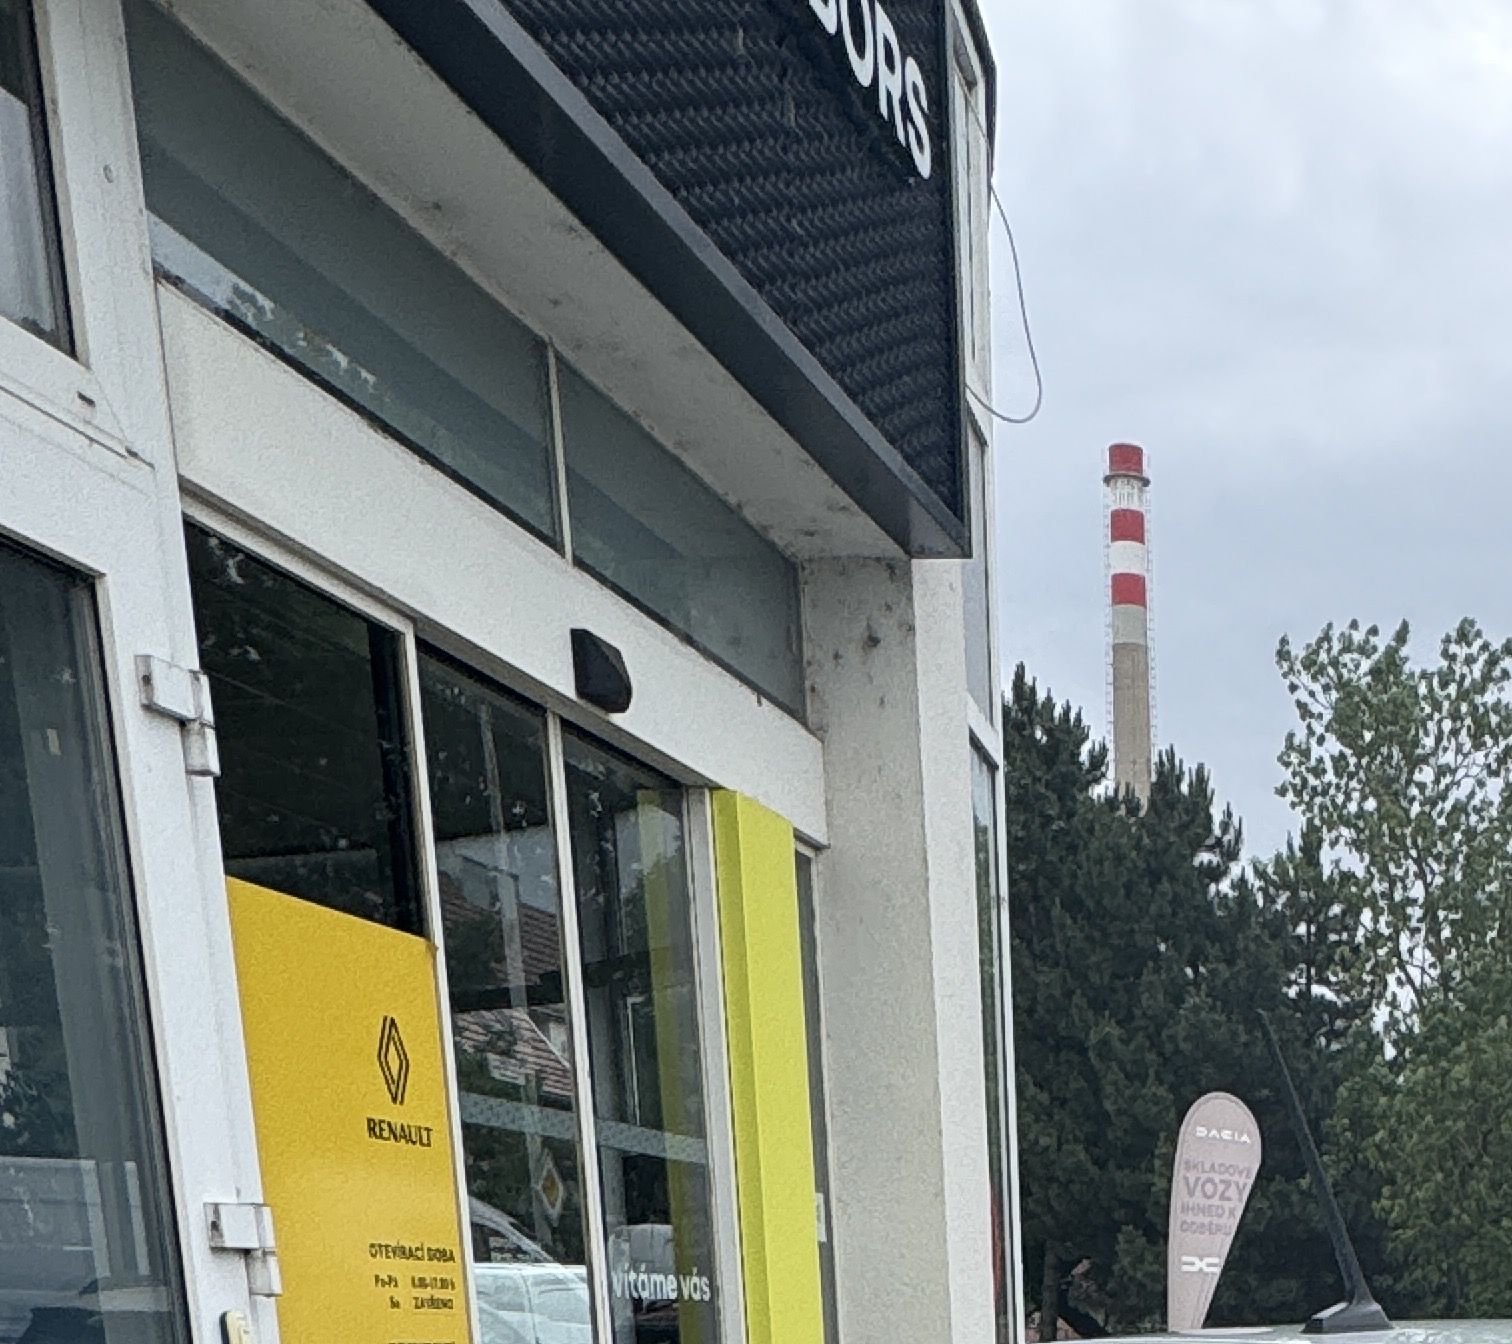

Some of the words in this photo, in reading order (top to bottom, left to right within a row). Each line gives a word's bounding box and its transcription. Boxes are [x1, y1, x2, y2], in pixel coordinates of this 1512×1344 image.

[808, 0, 932, 180] ORS
[366, 1117, 433, 1147] RENAULT
[1195, 1126, 1251, 1144] DACIA
[1183, 1175, 1248, 1202] VOZY
[611, 1262, 678, 1300] vítáme
[680, 1266, 711, 1302] vás
